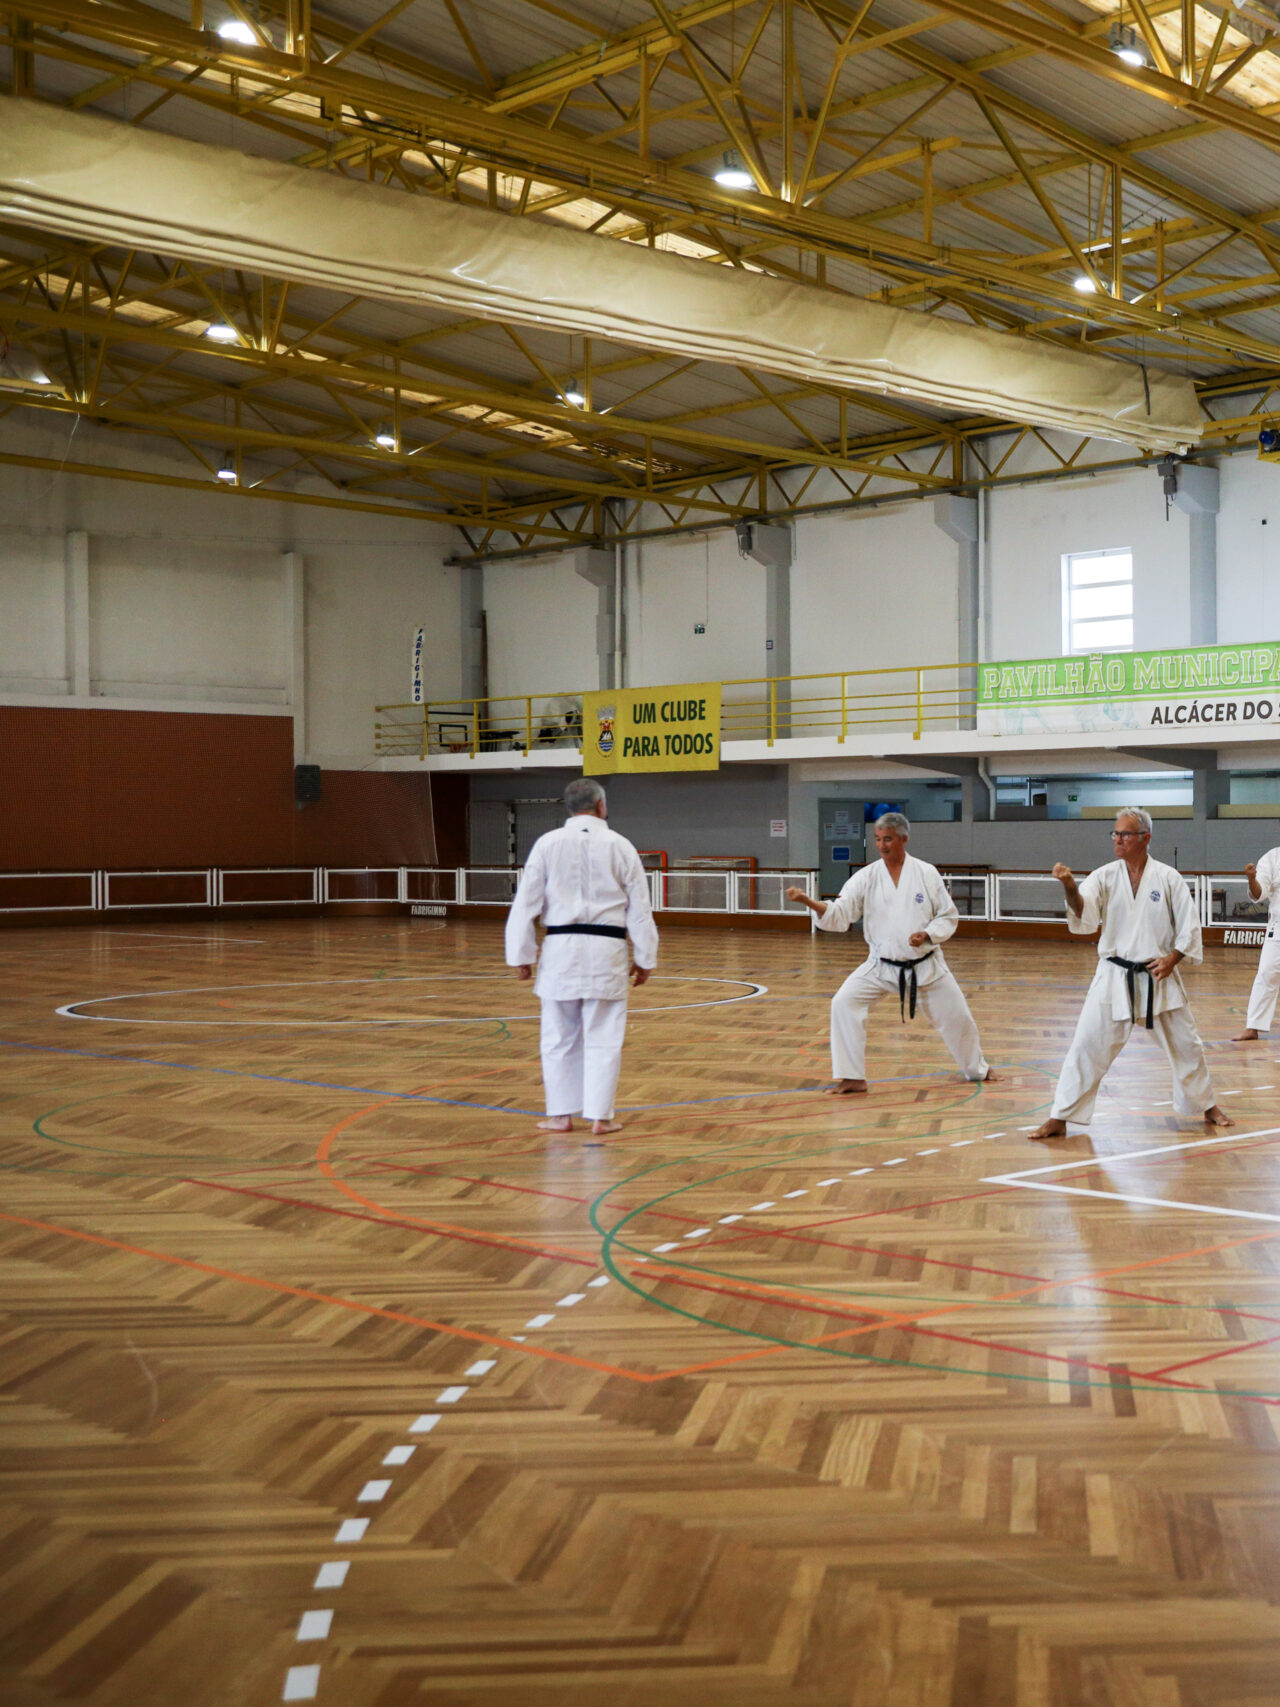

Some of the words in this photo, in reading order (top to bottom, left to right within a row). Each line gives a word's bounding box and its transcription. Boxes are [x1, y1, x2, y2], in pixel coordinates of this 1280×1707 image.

[413, 628, 424, 702] FABRIGIMNO
[983, 653, 1126, 699] PAVILHÃO
[632, 702, 656, 724] UM
[660, 699, 706, 723] CLUBE
[1150, 699, 1238, 725] ALCÁCER
[1242, 699, 1273, 721] DO
[623, 735, 660, 757] PARA
[664, 733, 714, 756] TODOS
[1223, 930, 1266, 945] FABRIG
